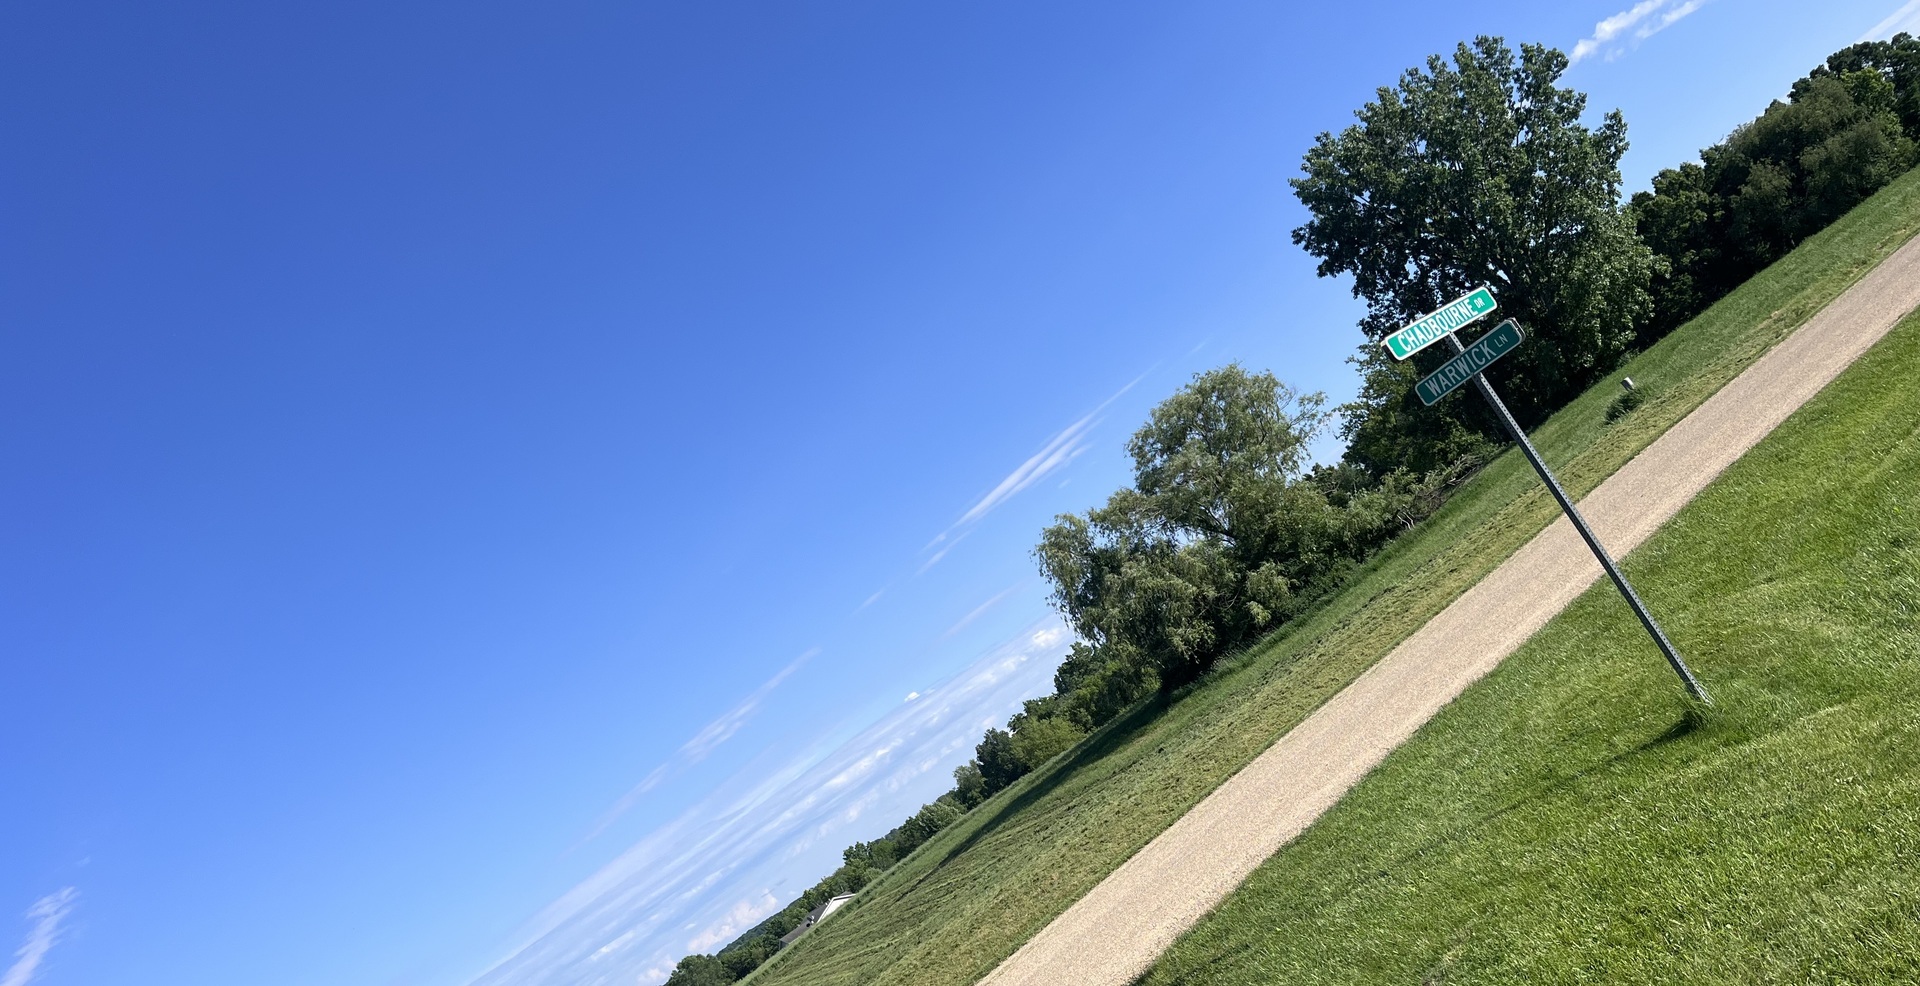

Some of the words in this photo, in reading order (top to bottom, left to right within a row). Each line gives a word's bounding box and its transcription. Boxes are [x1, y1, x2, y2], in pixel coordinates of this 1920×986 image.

[1398, 299, 1478, 352] CHADBOURNE
[1474, 297, 1485, 309] DR
[1425, 340, 1497, 397] WARWICK
[1494, 334, 1508, 348] LN
